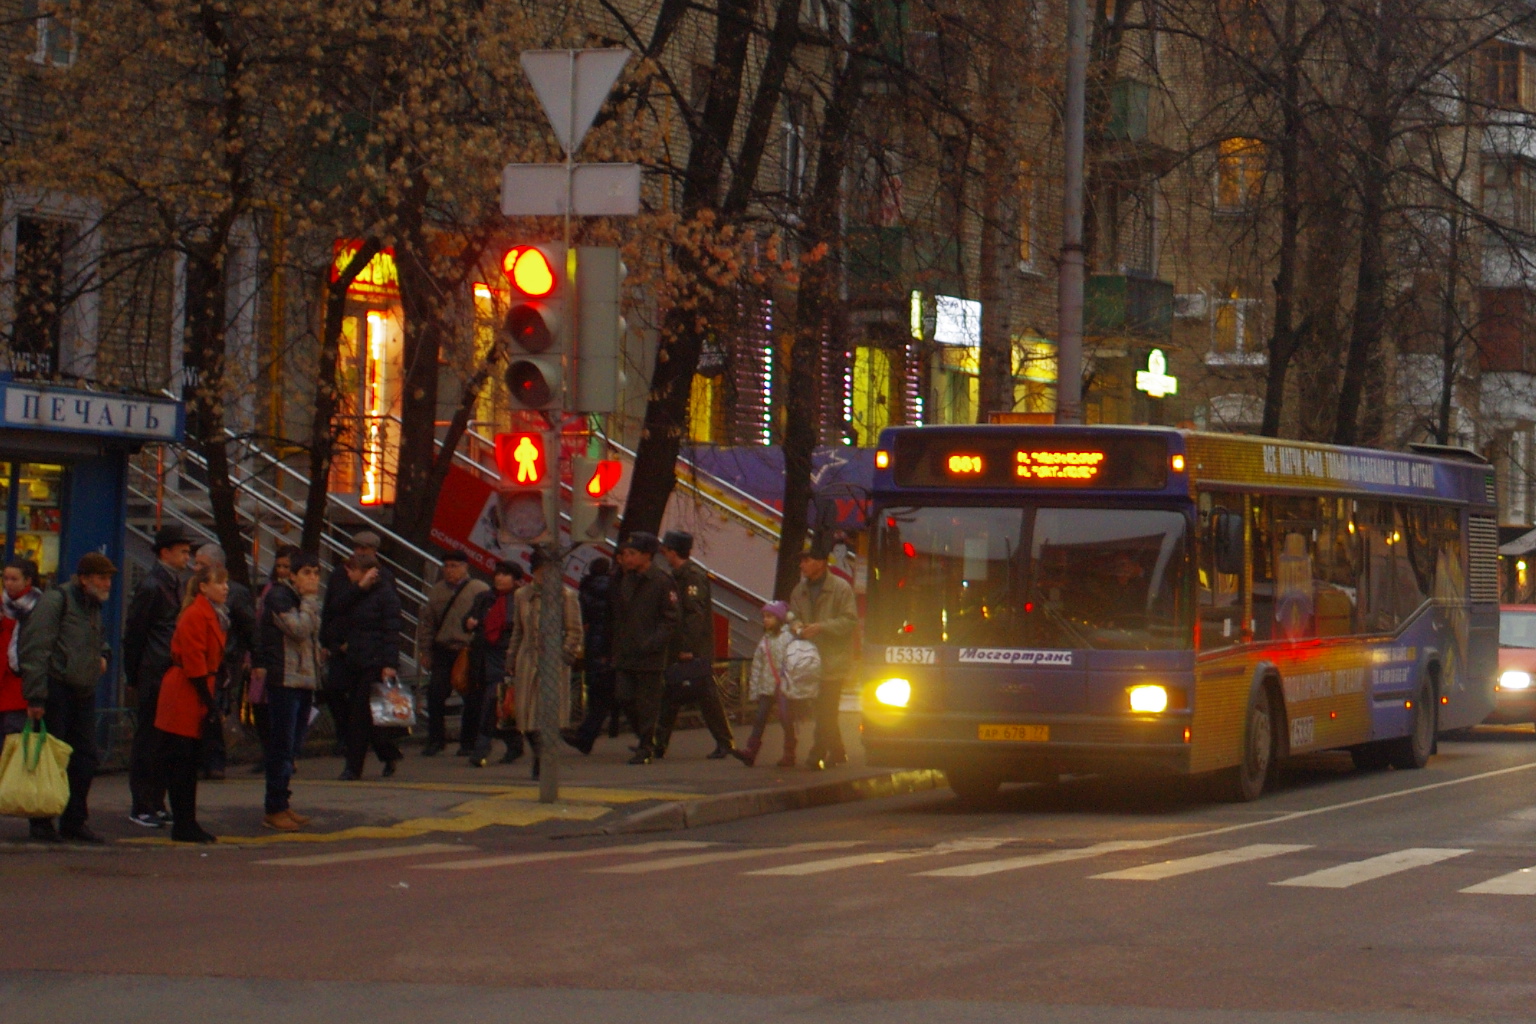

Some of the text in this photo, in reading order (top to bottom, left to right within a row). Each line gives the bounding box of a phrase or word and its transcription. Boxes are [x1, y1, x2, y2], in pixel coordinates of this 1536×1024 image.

[22, 394, 160, 430] ПЕЧАТЬ
[886, 647, 934, 663] 15337
[960, 648, 1072, 664] Мосгортранс
